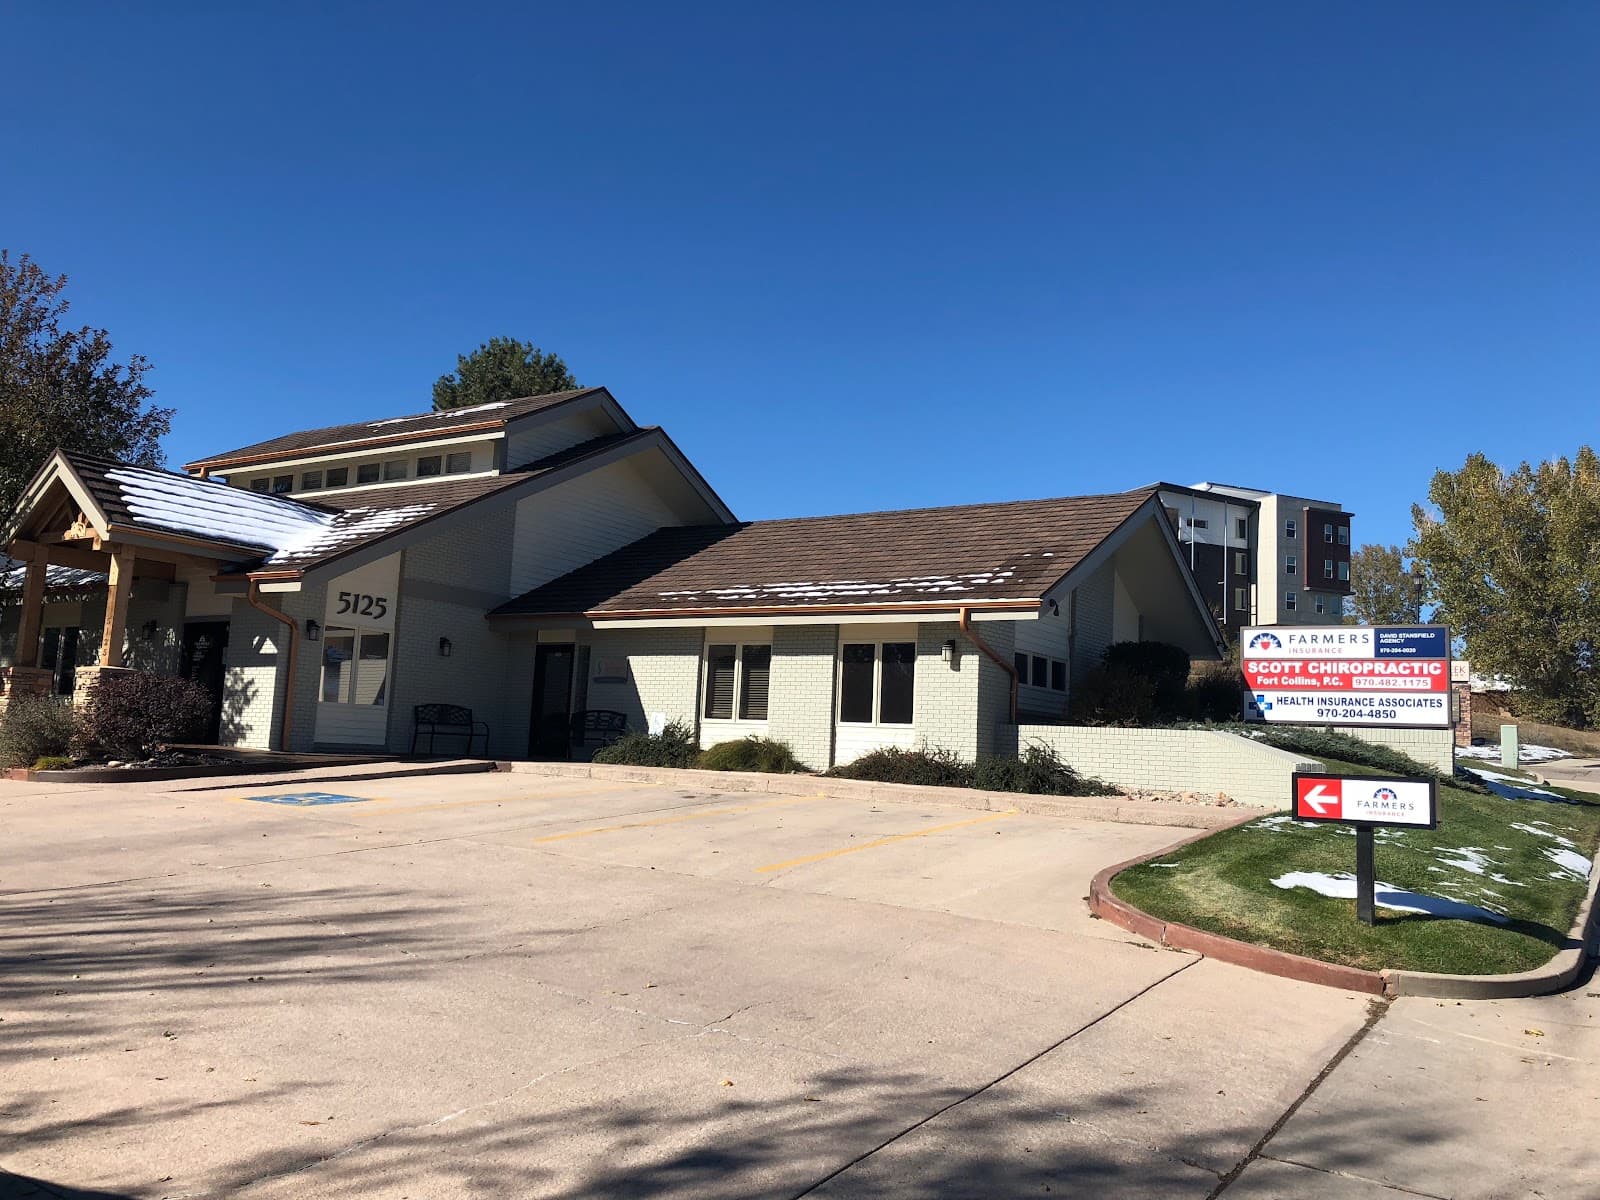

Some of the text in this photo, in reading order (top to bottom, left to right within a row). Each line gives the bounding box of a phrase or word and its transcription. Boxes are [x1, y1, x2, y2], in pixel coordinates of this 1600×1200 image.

[336, 591, 387, 620] 5125
[1289, 634, 1370, 644] FARMERS
[1248, 662, 1441, 674] SCOTT CHIROPRACTIC
[1257, 676, 1343, 687] Fort Collins, P.C.
[1355, 679, 1428, 687] 970.482.1175
[1277, 696, 1442, 708] HEALTH INSURANCE ASSOCIATES
[1317, 709, 1396, 718] 970-204-4850
[1357, 800, 1414, 810] FARMERS
